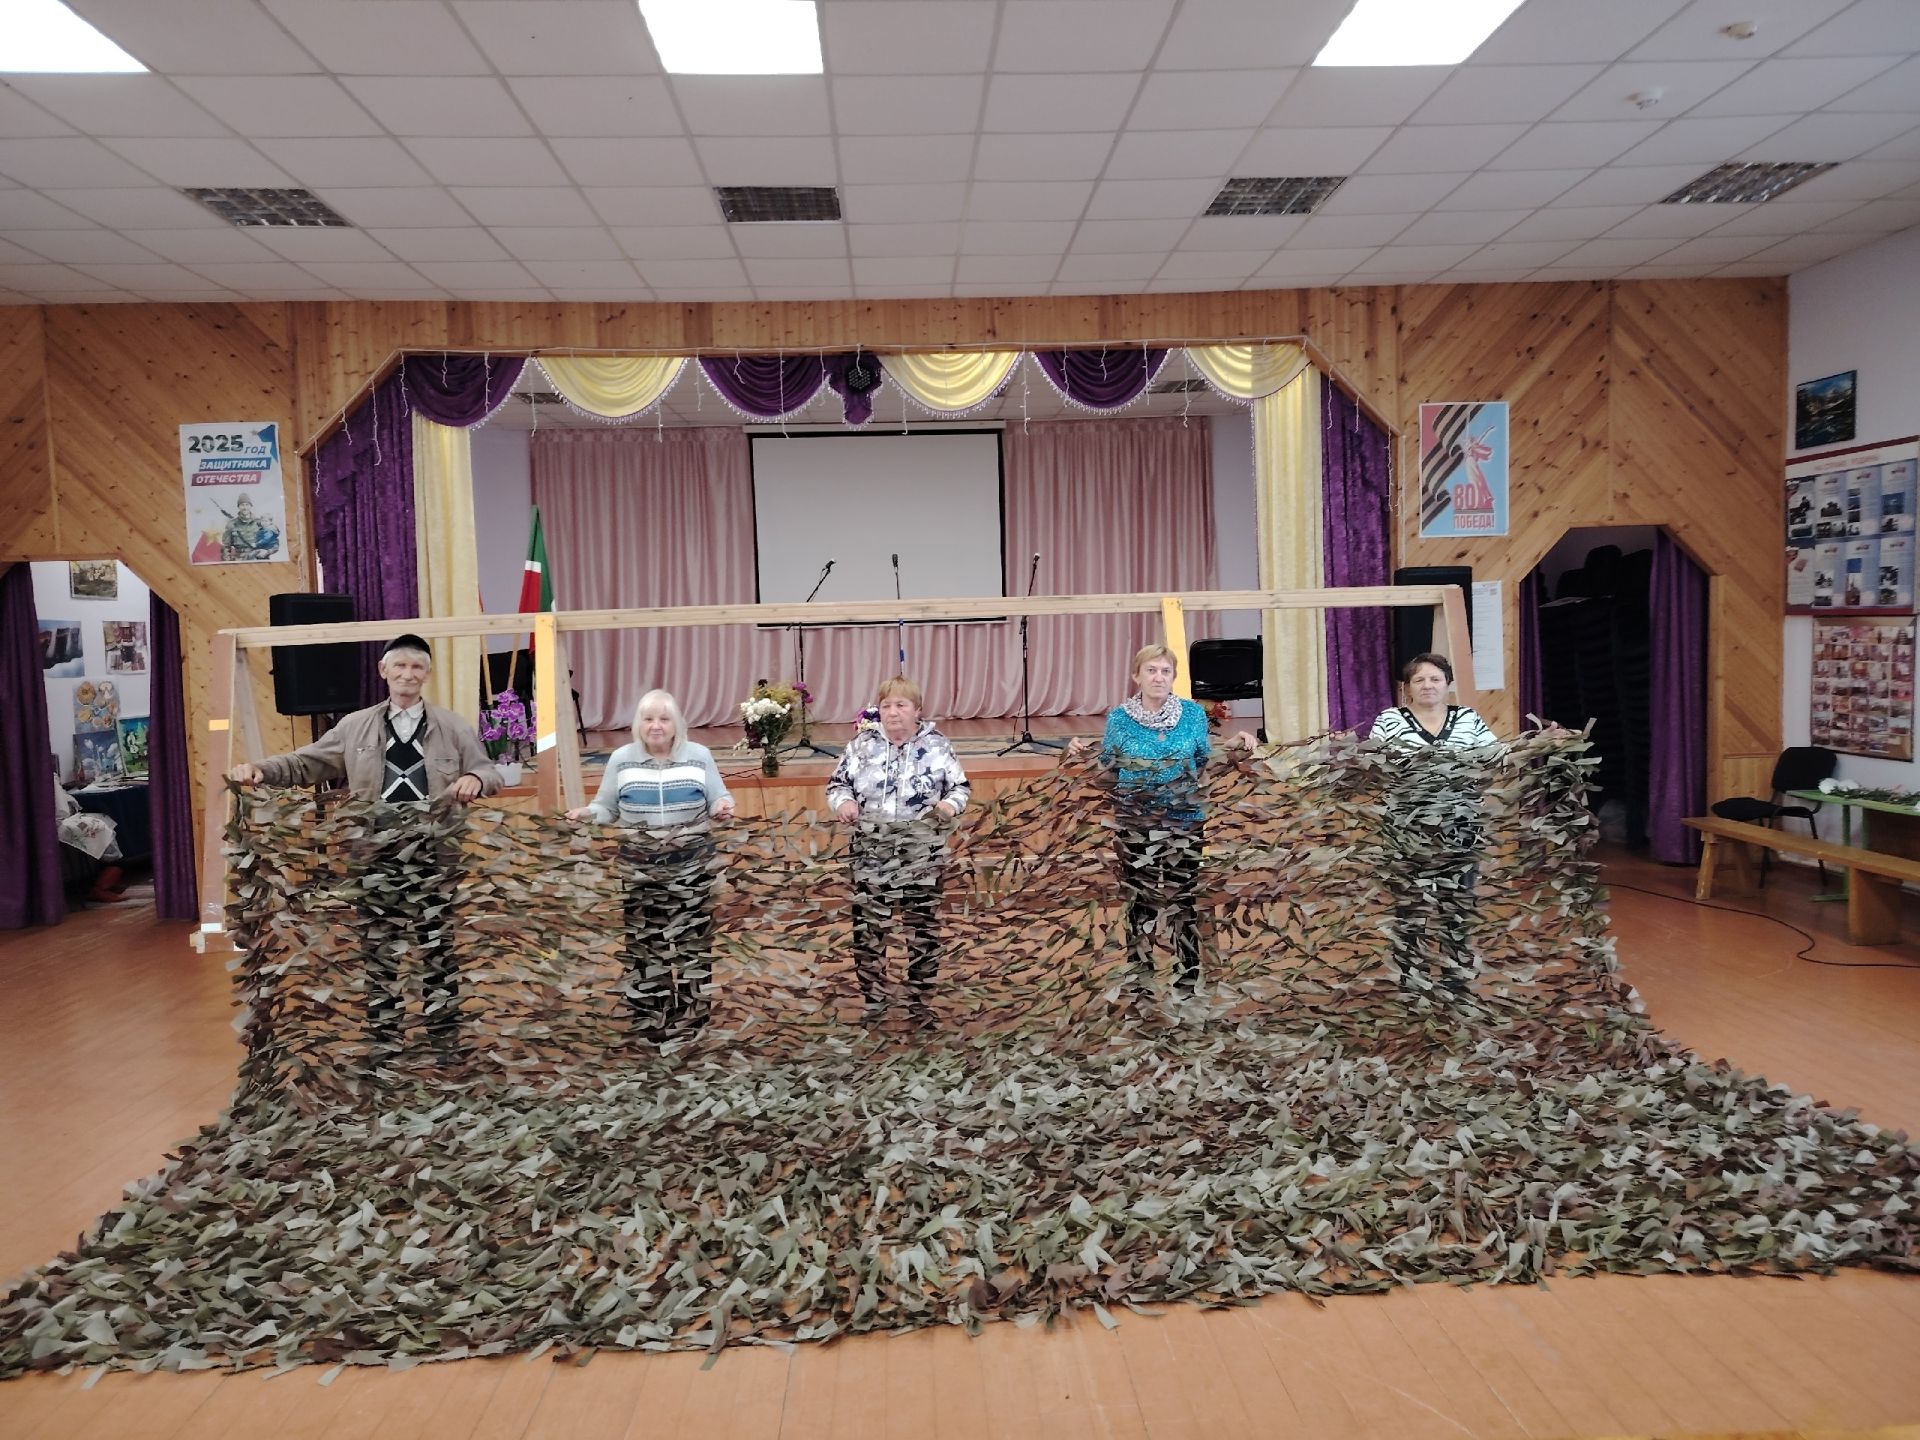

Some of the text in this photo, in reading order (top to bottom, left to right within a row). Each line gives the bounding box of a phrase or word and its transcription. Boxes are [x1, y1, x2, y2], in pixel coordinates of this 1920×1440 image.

[188, 434, 244, 453] 2025
[200, 459, 267, 470] ЗАЩИТНИКА
[196, 473, 257, 484] ОТЕЧЕСТВА
[1454, 483, 1476, 508] 80
[1453, 514, 1495, 529] ПОБЕДА!
